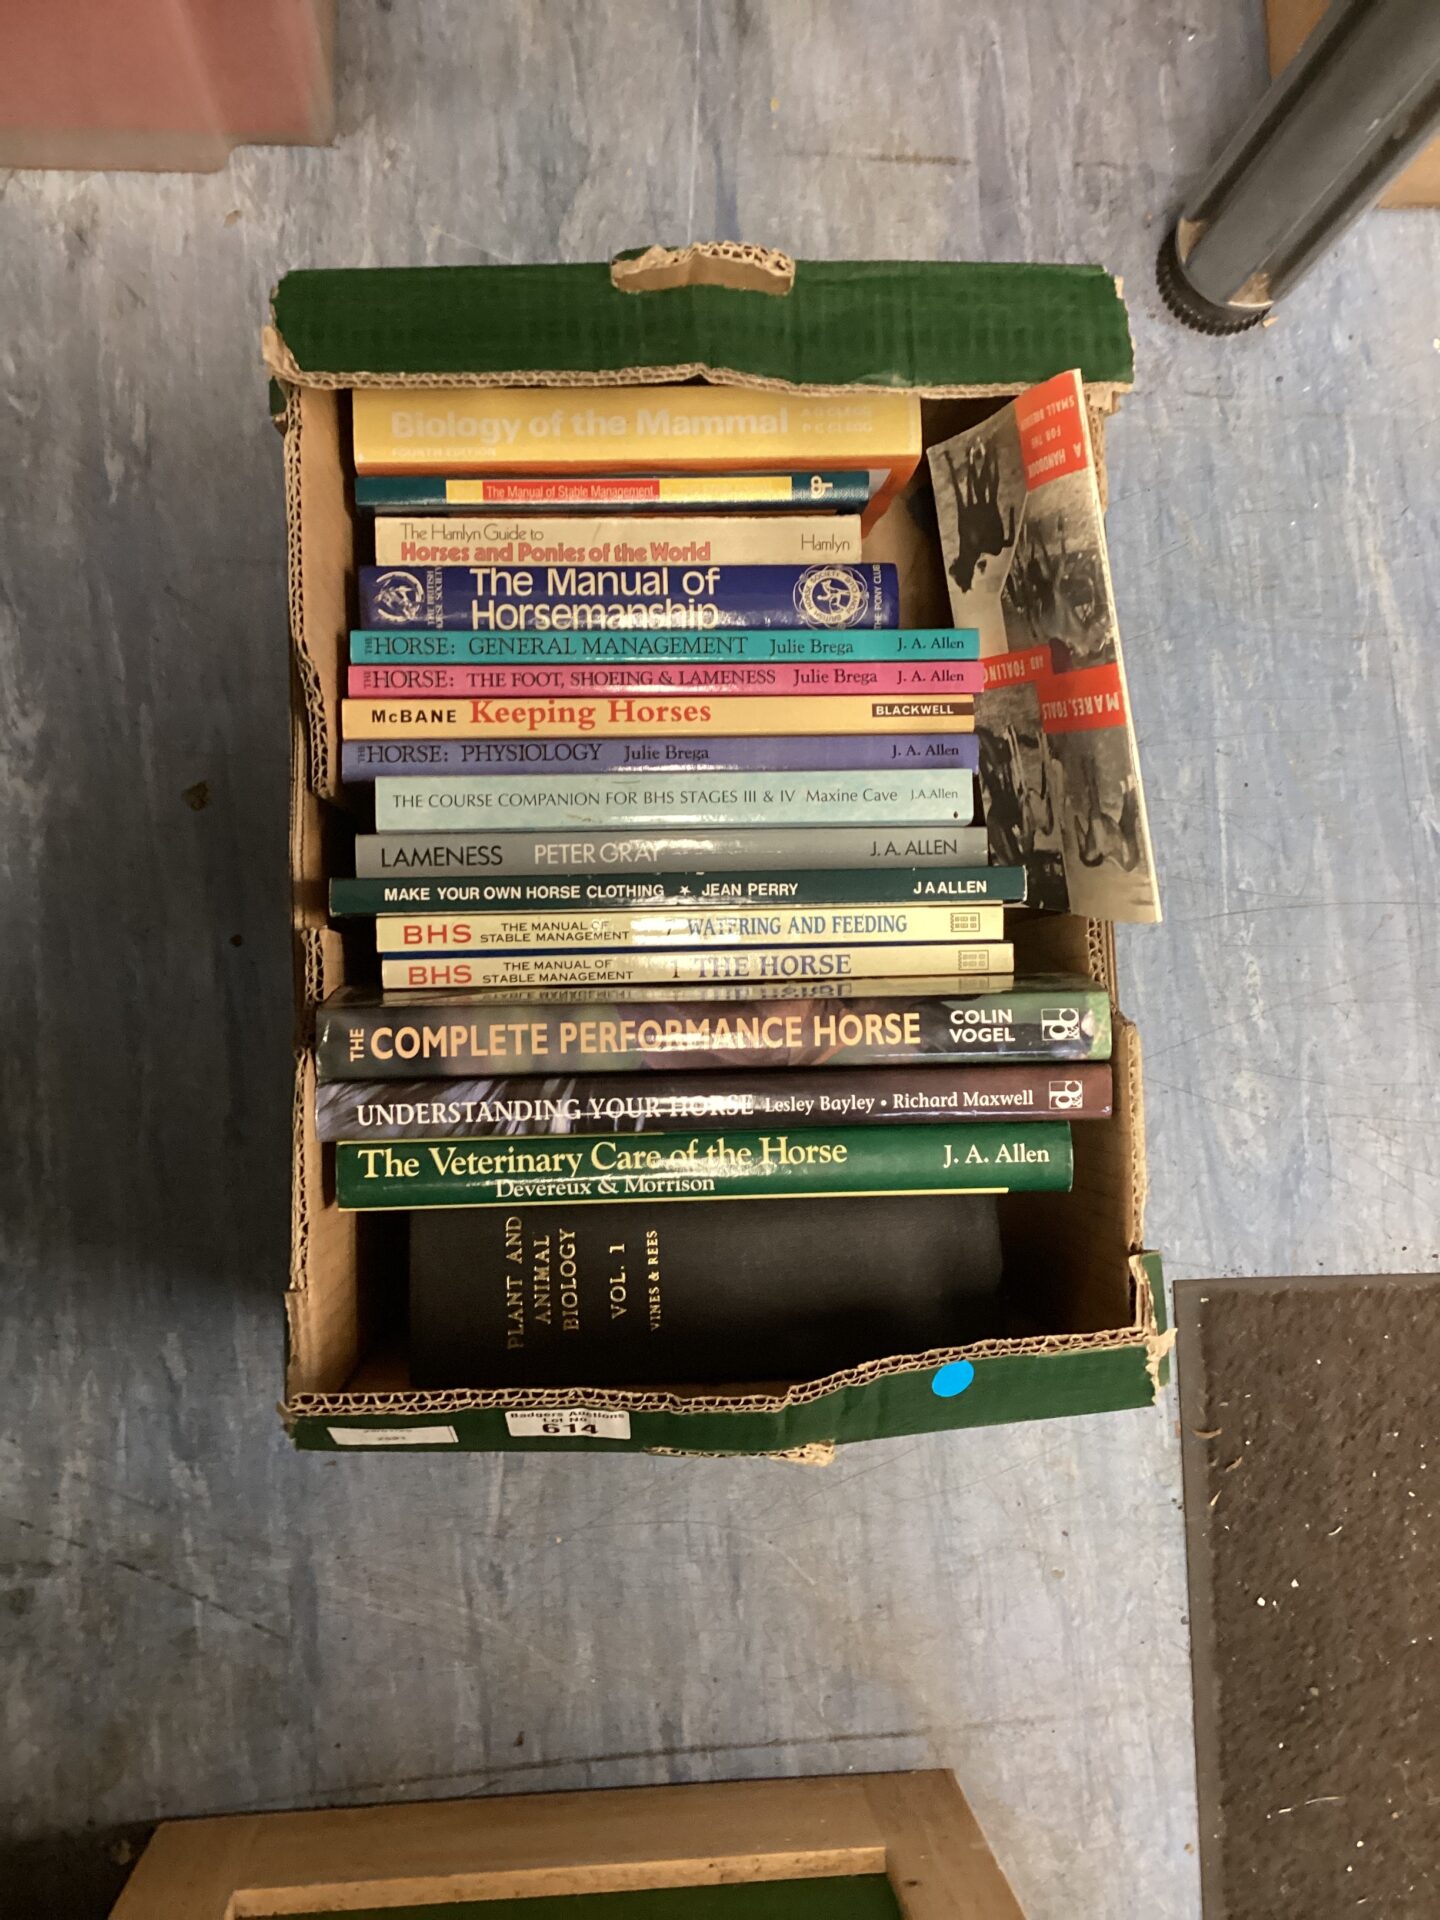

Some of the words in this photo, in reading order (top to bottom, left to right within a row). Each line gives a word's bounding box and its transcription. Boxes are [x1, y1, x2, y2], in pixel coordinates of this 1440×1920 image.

[1046, 395, 1075, 417] SMALL
[392, 410, 520, 443] Biology
[529, 411, 563, 438] of
[571, 410, 626, 437] the
[636, 408, 788, 436] Mammal
[487, 485, 508, 498] The
[510, 485, 544, 498] Manual
[546, 484, 556, 498] of
[558, 484, 591, 498] Stable
[593, 484, 654, 500] Management
[400, 523, 427, 541] The
[431, 522, 481, 542] Hamlyn
[484, 522, 527, 541] Guide
[530, 527, 544, 541] to
[401, 542, 469, 562] Horses
[474, 542, 514, 562] and
[518, 542, 585, 562] Ponies
[588, 542, 610, 562] of
[614, 542, 647, 562] the
[650, 542, 711, 562] World
[802, 534, 850, 554] Hamlyn
[470, 568, 534, 596] The
[548, 567, 668, 596] Manual
[682, 567, 720, 596] of
[872, 564, 881, 584] CLUB
[874, 586, 882, 610] PONY
[472, 598, 719, 630] Horsemanship
[874, 612, 882, 630] THE
[375, 637, 455, 655] HORSE:
[469, 637, 576, 655] GENERAL
[582, 636, 748, 655] MANAGEMENT
[770, 638, 804, 655] Julie
[810, 639, 854, 654] Brega
[897, 637, 908, 650] J.
[911, 637, 926, 650] A.
[930, 636, 964, 650] Allen
[374, 670, 454, 688] HORSE:
[466, 672, 506, 688] THE
[512, 672, 565, 690] FOOT,
[570, 671, 653, 687] SHOEING
[658, 671, 673, 686] &
[678, 670, 776, 686] LAMENESS
[793, 669, 830, 686] Julie
[834, 670, 878, 686] Brega
[896, 670, 907, 684] J.
[910, 670, 926, 682] A.
[930, 669, 964, 682] Allen
[372, 709, 457, 724] McBANE
[470, 700, 596, 730] Keeping
[608, 700, 712, 723] Horses
[876, 704, 954, 716] BLACKWELL
[1042, 700, 1067, 720] FOALS
[368, 745, 448, 763] HORSE:
[461, 744, 602, 762] PHYSIOLOGY
[624, 745, 660, 762] Julie
[666, 745, 709, 762] Brega
[891, 744, 902, 758] J.
[906, 744, 921, 757] A.
[926, 744, 959, 756] Allen
[393, 794, 423, 808] THE
[428, 794, 493, 808] COURSE
[498, 792, 600, 808] COMPANION
[605, 792, 638, 806] FOR
[644, 790, 674, 804] BHS
[680, 790, 738, 804] STAGES
[744, 790, 756, 803] III
[762, 791, 774, 802] &
[780, 790, 796, 802] IV
[806, 788, 858, 802] Maxine
[862, 788, 898, 802] Cave
[381, 846, 503, 868] LAMENESS
[534, 844, 596, 865] PETER
[600, 843, 661, 864] GRAY
[870, 840, 880, 856] J.
[884, 840, 902, 856] A.
[904, 839, 958, 856] ALLEN
[384, 888, 430, 901] MAKE
[437, 886, 480, 900] YOUR
[484, 886, 522, 900] OWN
[526, 885, 581, 898] HORSE
[586, 884, 665, 898] CLOTHING
[702, 883, 742, 896] JEAN
[748, 882, 798, 896] PERRY
[404, 924, 472, 944] BHS
[501, 922, 526, 932] THE
[532, 921, 588, 932] MANUAL
[591, 920, 608, 930] OF
[688, 917, 782, 936] WATERING
[788, 916, 826, 934] AND
[832, 914, 908, 934] FEEDING
[480, 934, 530, 943] STABLE
[536, 931, 629, 942] MANAGEMENT
[408, 965, 472, 986] BHS
[504, 962, 529, 971] THE
[534, 960, 592, 970] MANUAL
[595, 960, 612, 969] OF
[695, 957, 750, 978] THE
[760, 954, 852, 978] HORSE
[482, 974, 535, 984] STABLE
[539, 971, 634, 983] MANAGEMENT
[950, 1009, 1012, 1025] COLIN
[350, 1028, 365, 1062] THE
[371, 1023, 548, 1060] COMPLETE
[560, 1016, 802, 1054] PERFORMANCE
[814, 1012, 921, 1046] HORSE
[948, 1027, 1016, 1044] VOGEL
[357, 1099, 582, 1126] UNDERSTANDING
[590, 1097, 660, 1120] YOUR
[669, 1095, 754, 1118] HORSE
[764, 1096, 814, 1115] Lesley
[820, 1095, 876, 1114] Bayley
[892, 1092, 958, 1110] Richard
[962, 1090, 1034, 1108] Maxwell
[358, 1148, 420, 1178] The
[428, 1146, 582, 1178] Veterinary
[591, 1141, 662, 1171] Care
[668, 1138, 698, 1168] of
[706, 1138, 753, 1166] the
[758, 1135, 848, 1166] Horse
[944, 1144, 958, 1168] J.
[964, 1144, 990, 1164] A.
[996, 1142, 1050, 1163] Allen
[496, 1179, 592, 1198] Devereux
[597, 1176, 620, 1194] &
[624, 1176, 715, 1194] Morrison
[506, 1216, 523, 1264] AND
[610, 1244, 625, 1254] 1
[646, 1230, 658, 1265] REES
[534, 1235, 551, 1324] ANIMAL
[560, 1228, 580, 1331] BIOLOGY
[648, 1271, 660, 1282] &
[610, 1266, 627, 1320] VOL.
[506, 1276, 525, 1350] PLANT
[649, 1286, 662, 1331] VINES
[569, 1410, 625, 1419] Auctions
[542, 1423, 599, 1434] 614
